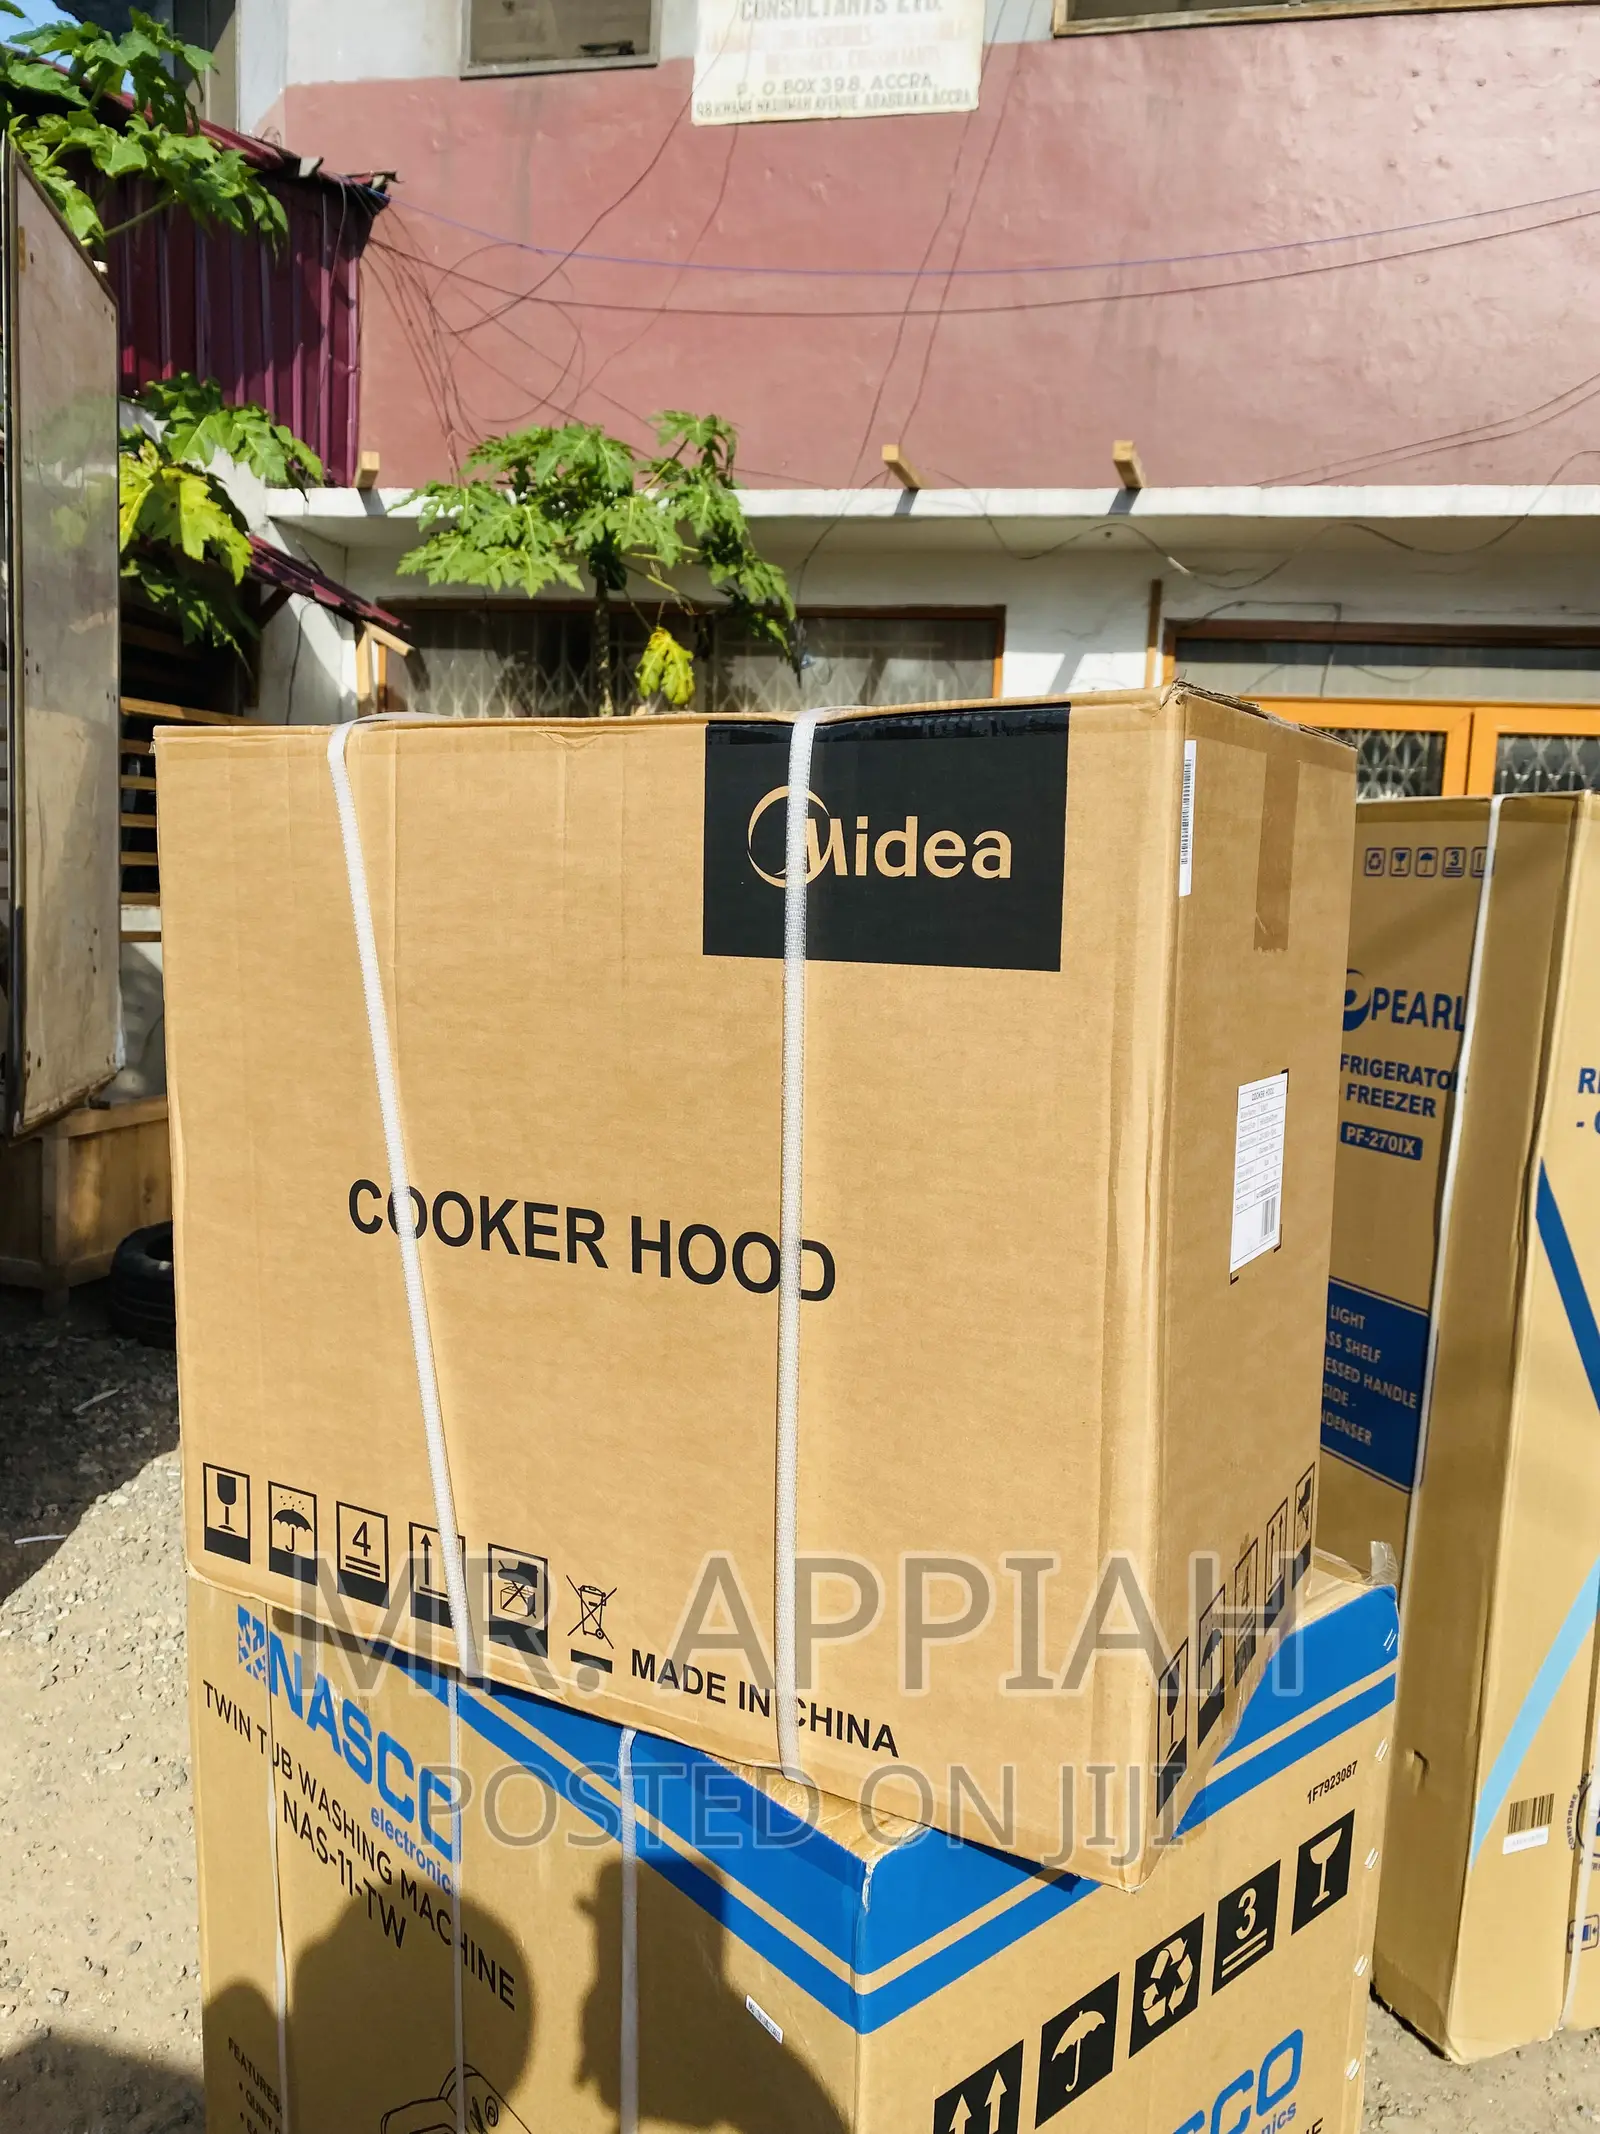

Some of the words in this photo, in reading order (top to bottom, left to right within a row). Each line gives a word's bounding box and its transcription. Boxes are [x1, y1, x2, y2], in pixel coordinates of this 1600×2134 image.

[800, 812, 1011, 882] Midea
[1450, 851, 1460, 866] 3
[1371, 987, 1464, 1032] PEARL
[1346, 1083, 1436, 1118] FREEZER
[1578, 1067, 1600, 1094] R
[349, 1179, 608, 1269] COOKER
[631, 1216, 836, 1302] HOOD
[1330, 1304, 1365, 1330] LIGHT
[1345, 1337, 1381, 1363] SHELF
[1363, 1374, 1417, 1408] HANDLE
[352, 1521, 371, 1557] 4
[632, 1648, 726, 1704] MADE
[739, 1681, 770, 1718] IN
[269, 1631, 461, 1864] NASCO
[1307, 1760, 1357, 1804] 1F7923087
[203, 1680, 251, 1742] TWIN
[298, 1762, 392, 1886] WASHING
[401, 1868, 514, 2011] MACHINE
[371, 1807, 456, 1897] electronic
[283, 1790, 406, 1949] NAS-11-TW
[1235, 1888, 1256, 1940] 3
